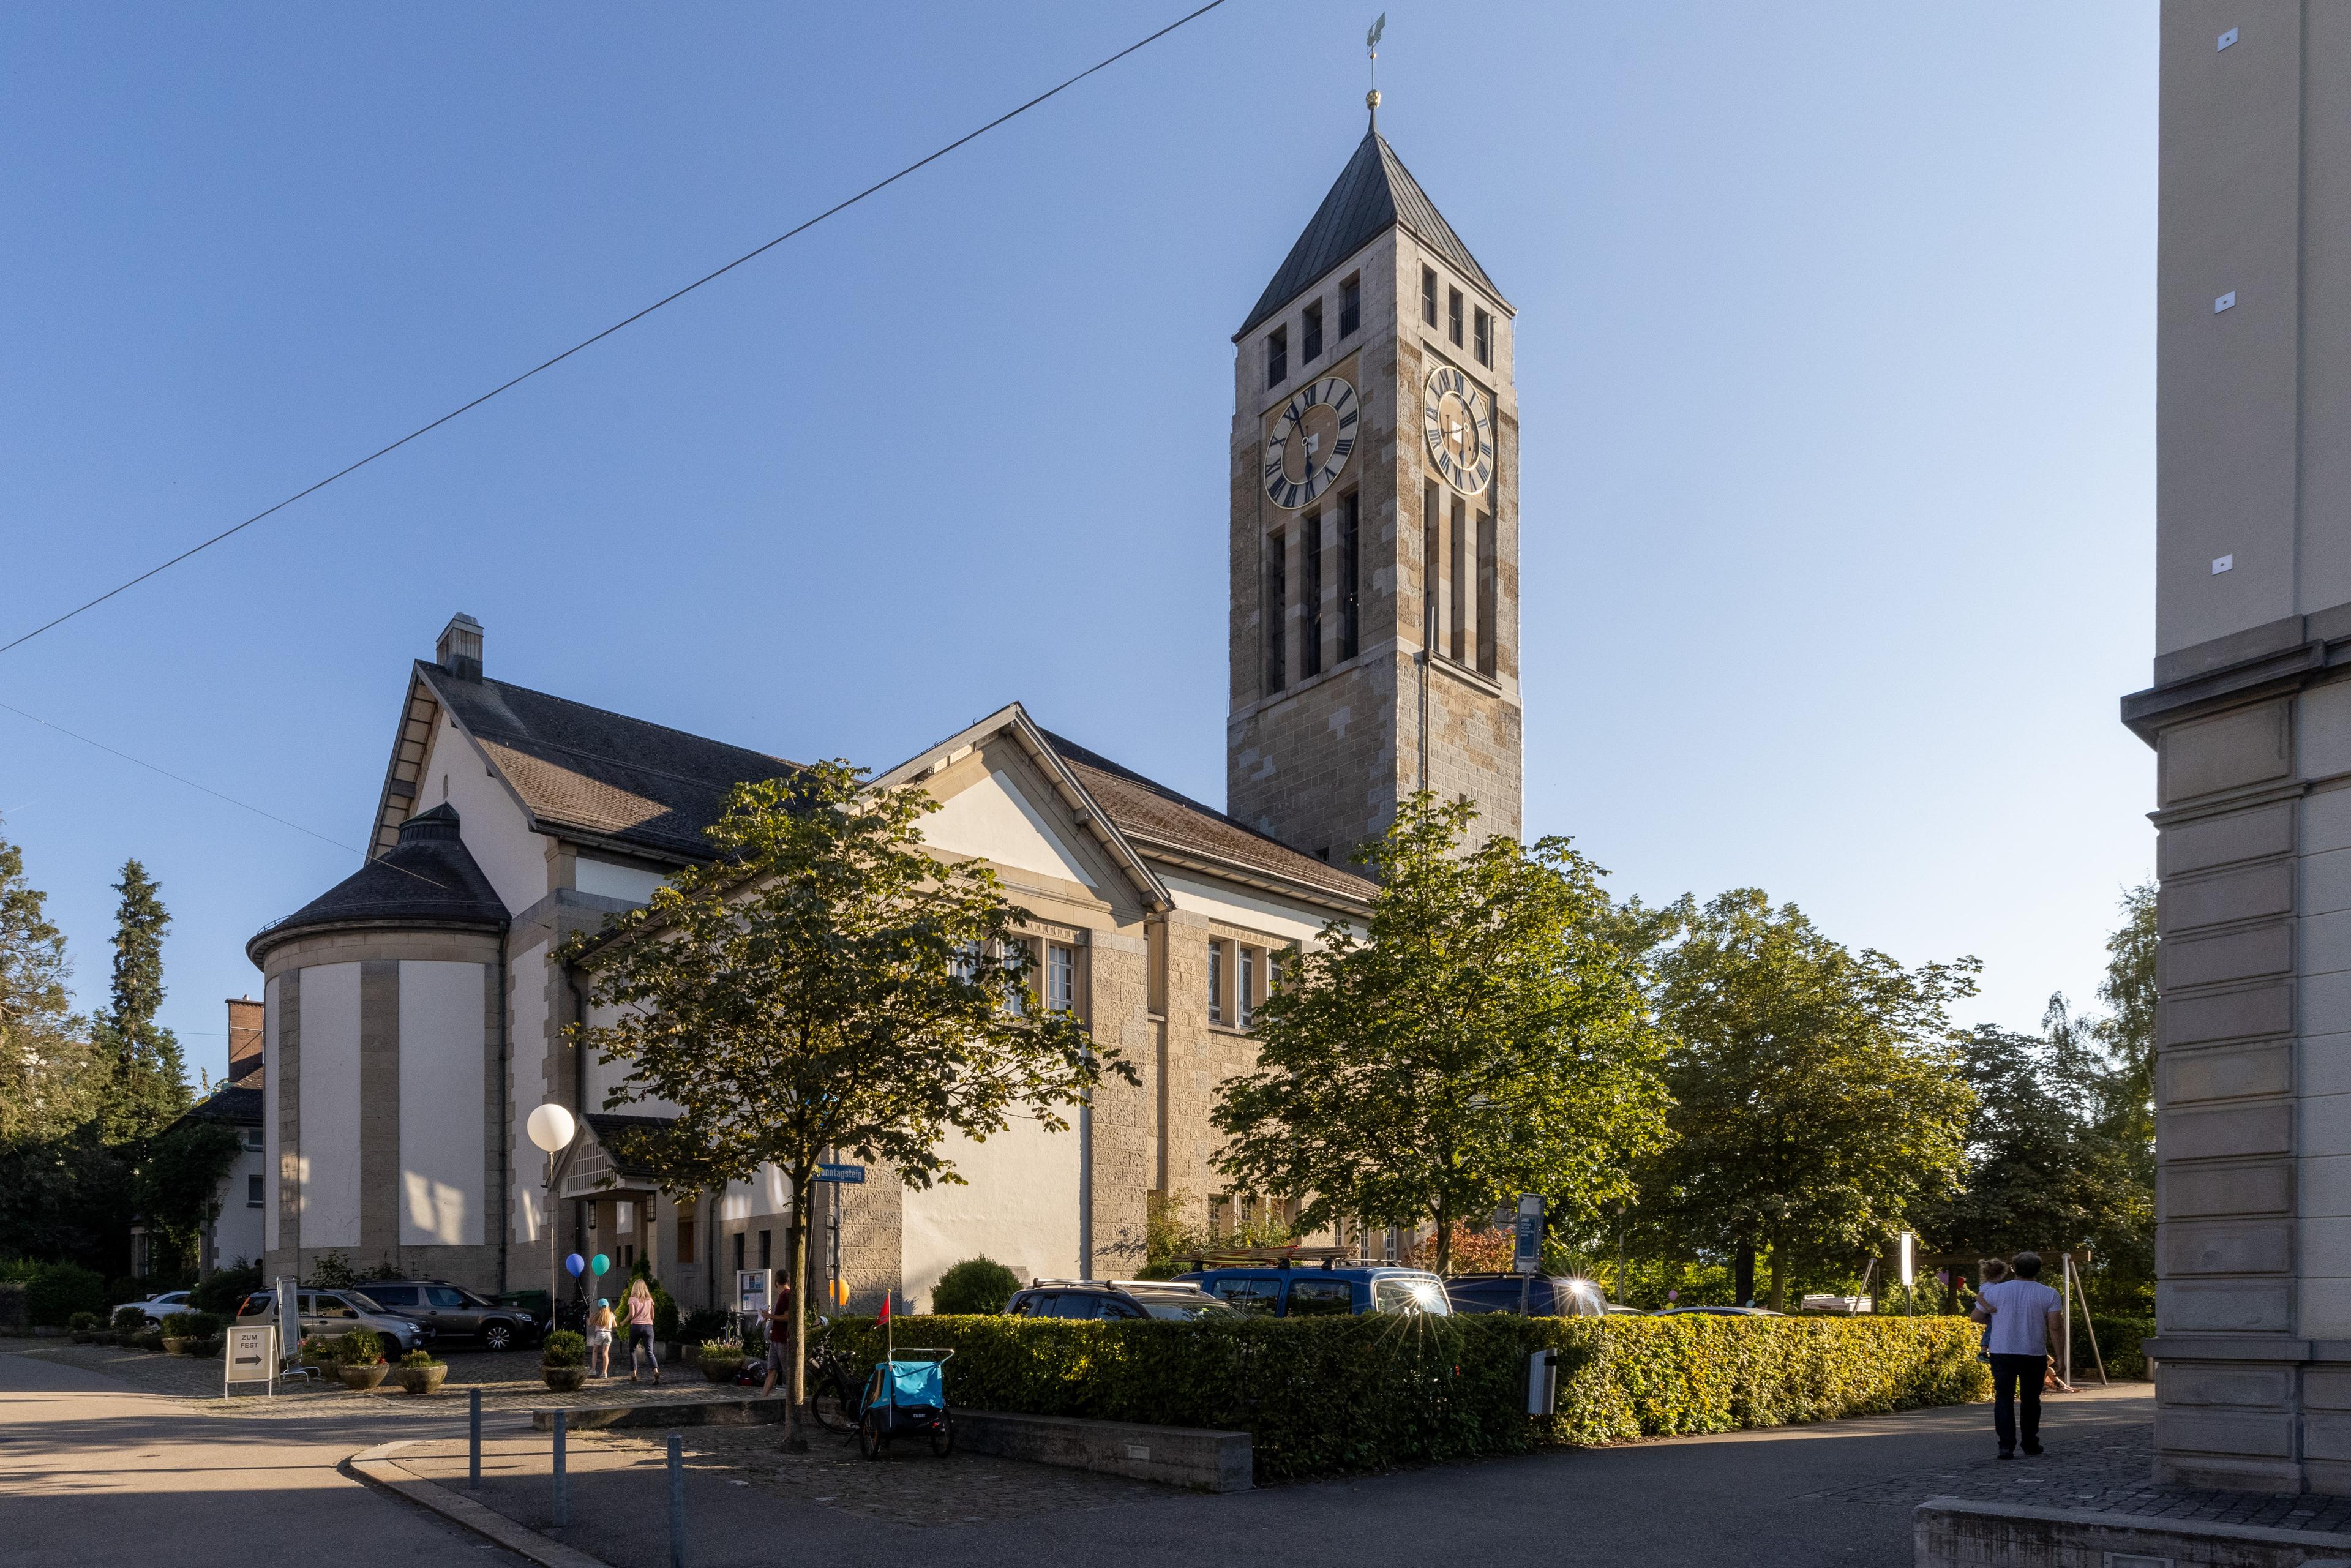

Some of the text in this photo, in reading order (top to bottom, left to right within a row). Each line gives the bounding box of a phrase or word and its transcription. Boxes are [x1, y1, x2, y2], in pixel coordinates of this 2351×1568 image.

[1303, 383, 1316, 411] XII
[1323, 377, 1335, 403] I
[1469, 390, 1477, 406] I
[1334, 386, 1353, 413] II
[1339, 409, 1358, 430] III
[1477, 418, 1489, 429] II
[1269, 435, 1288, 448] X
[1332, 439, 1354, 457] IIII
[1480, 443, 1492, 459] III
[1325, 466, 1337, 484] V
